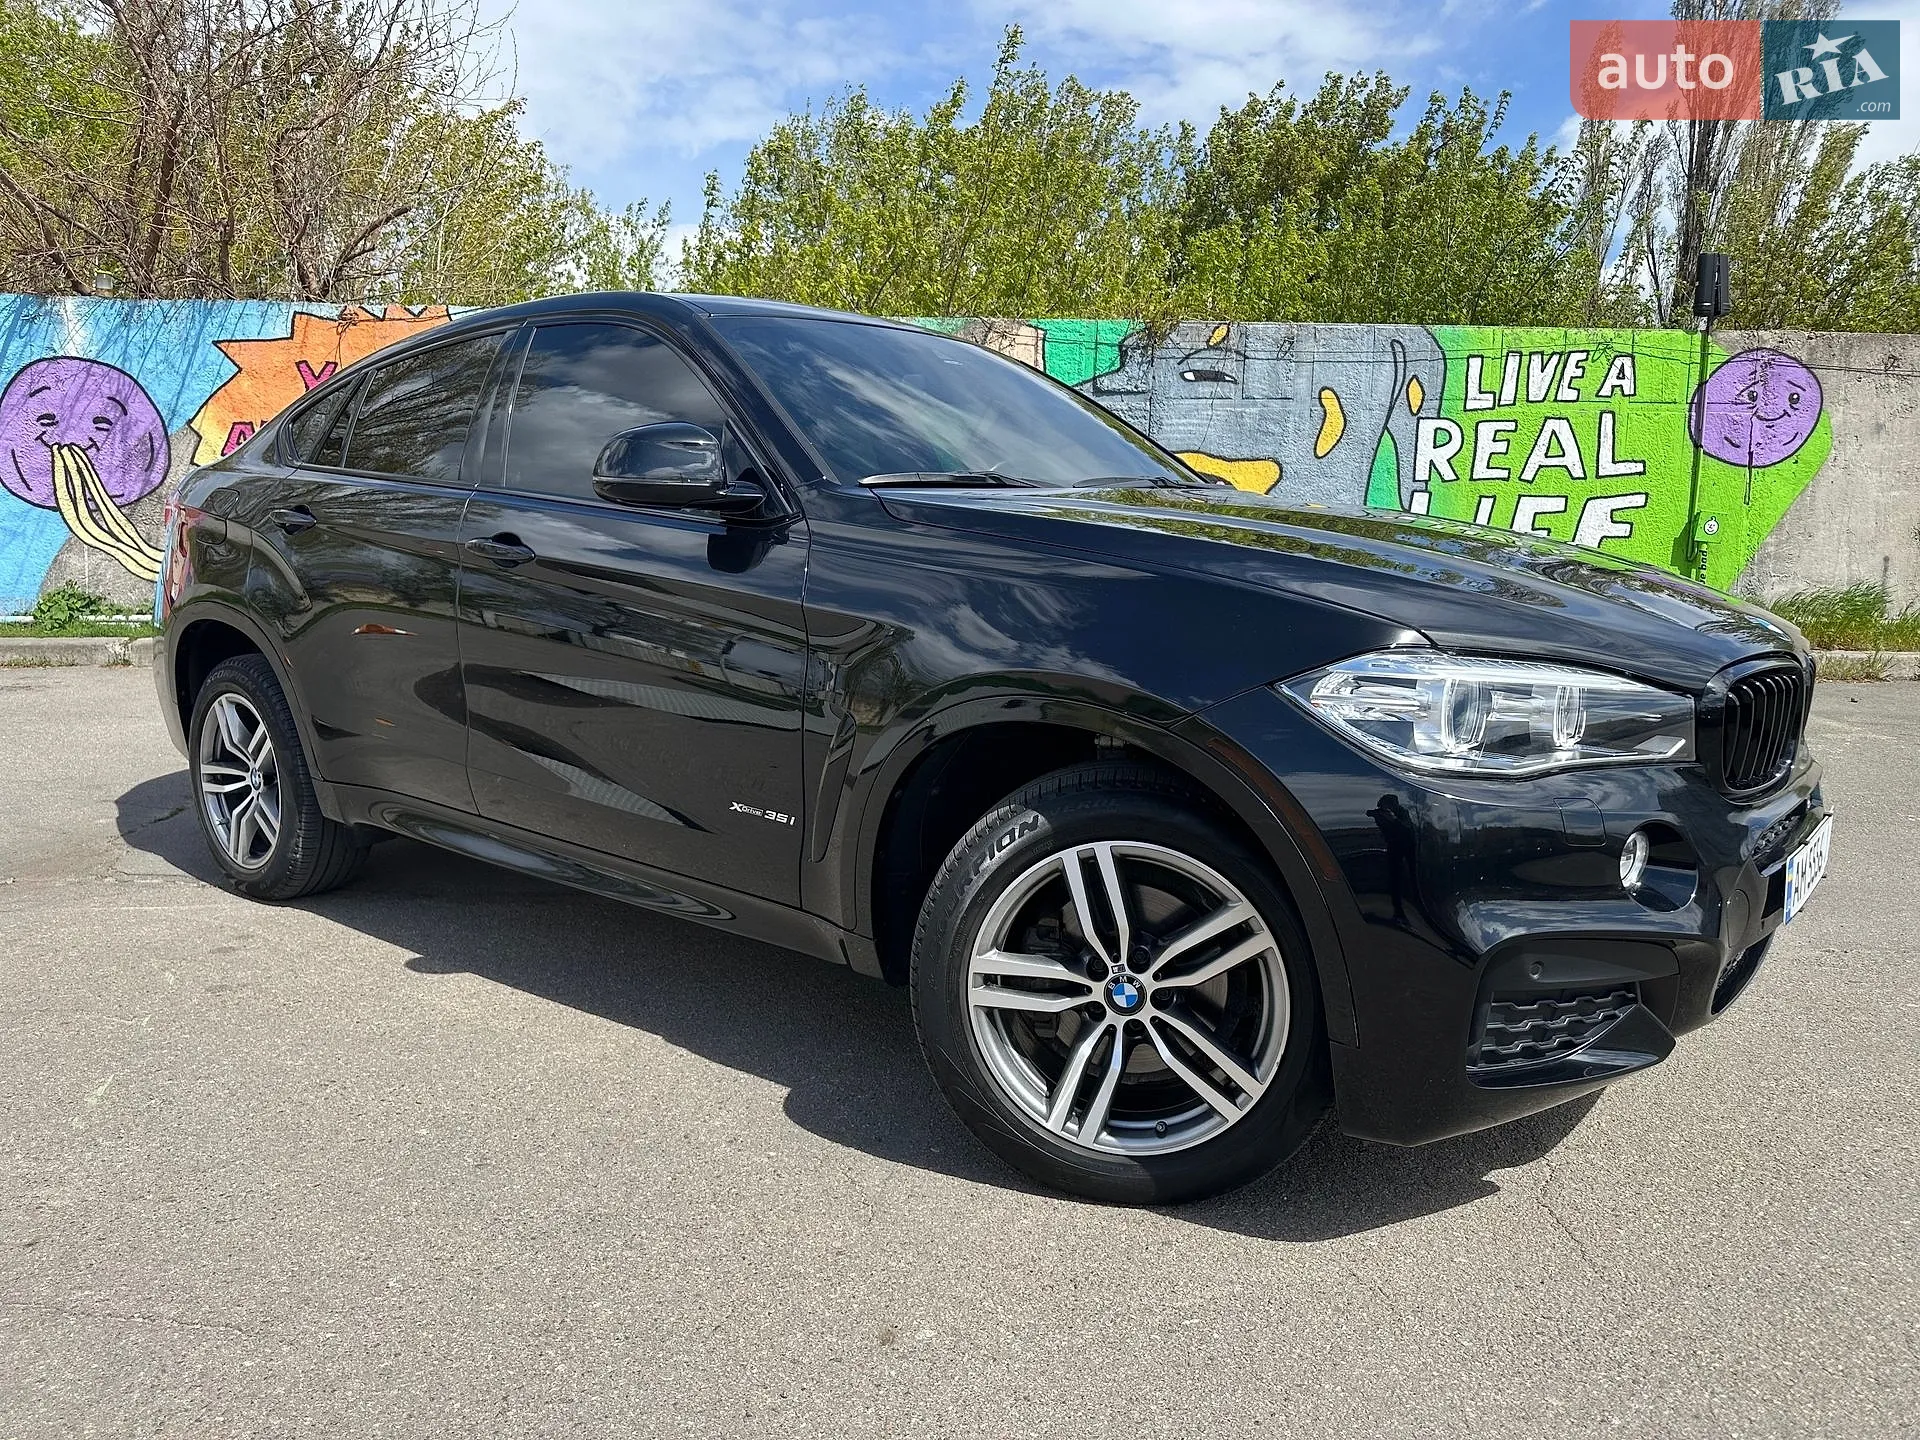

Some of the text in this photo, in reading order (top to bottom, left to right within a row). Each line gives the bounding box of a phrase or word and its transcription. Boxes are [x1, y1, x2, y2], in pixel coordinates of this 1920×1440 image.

[1464, 350, 1637, 412] LIVE A
[1413, 411, 1646, 483] REAL
